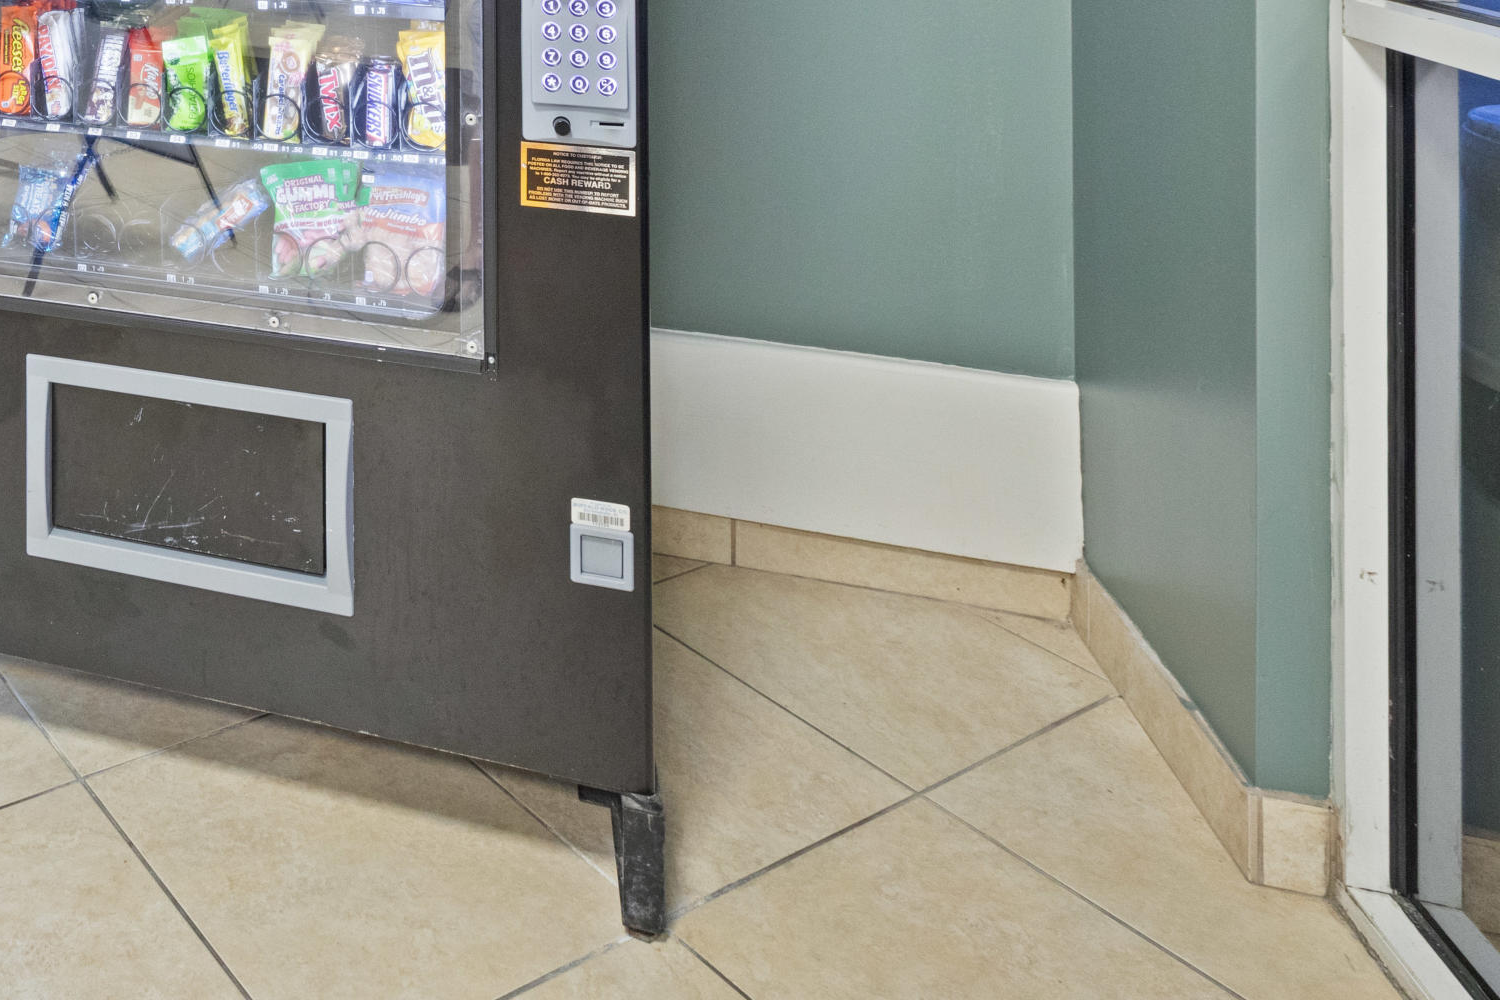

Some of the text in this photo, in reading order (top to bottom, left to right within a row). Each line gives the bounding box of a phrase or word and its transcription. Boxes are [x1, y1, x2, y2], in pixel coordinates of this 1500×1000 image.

[547, 1, 610, 12] 1 2 3
[547, 25, 610, 39] 4 5 6
[548, 52, 610, 65] 7 8 9
[575, 79, 583, 88] 0
[318, 67, 342, 132] TWIX
[366, 71, 384, 137] SNICKERS
[284, 175, 324, 187] ORIGINAL
[544, 177, 569, 185] CASH
[276, 184, 335, 203] GUMMI
[295, 201, 330, 213] FACTORY
